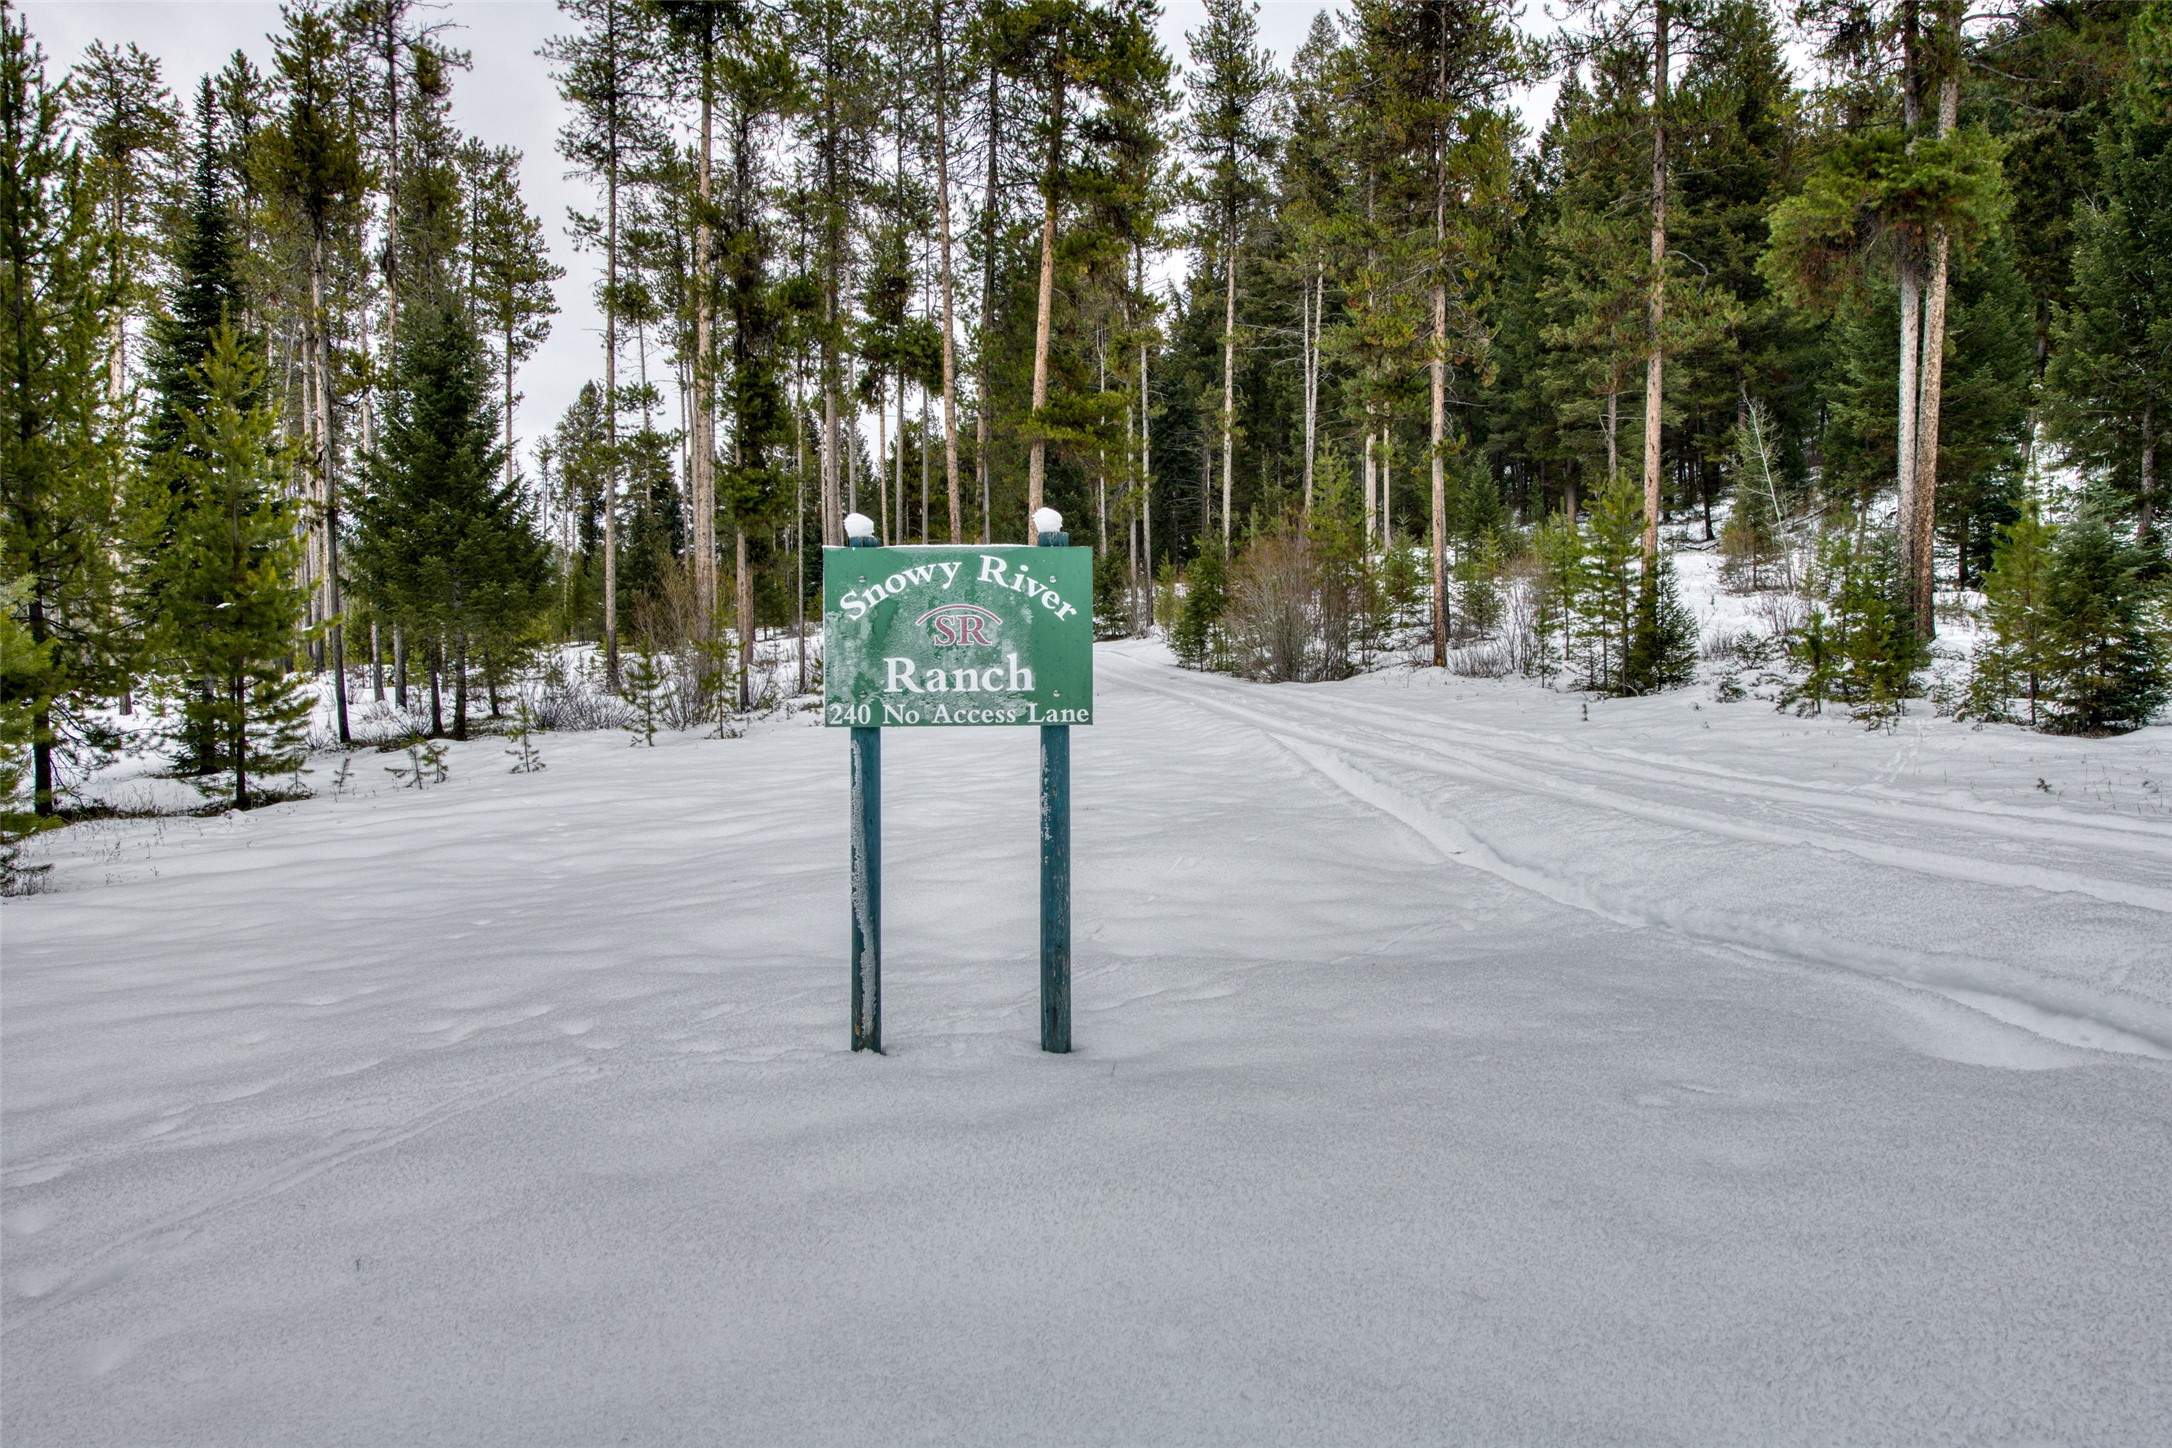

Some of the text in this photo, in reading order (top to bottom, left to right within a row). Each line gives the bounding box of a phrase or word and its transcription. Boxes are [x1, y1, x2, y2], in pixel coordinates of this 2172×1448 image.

[839, 554, 1078, 622] Snowy River
[933, 614, 993, 647] SR
[883, 652, 1036, 694] Ranch
[829, 702, 1090, 725] 240 No Access Lane
